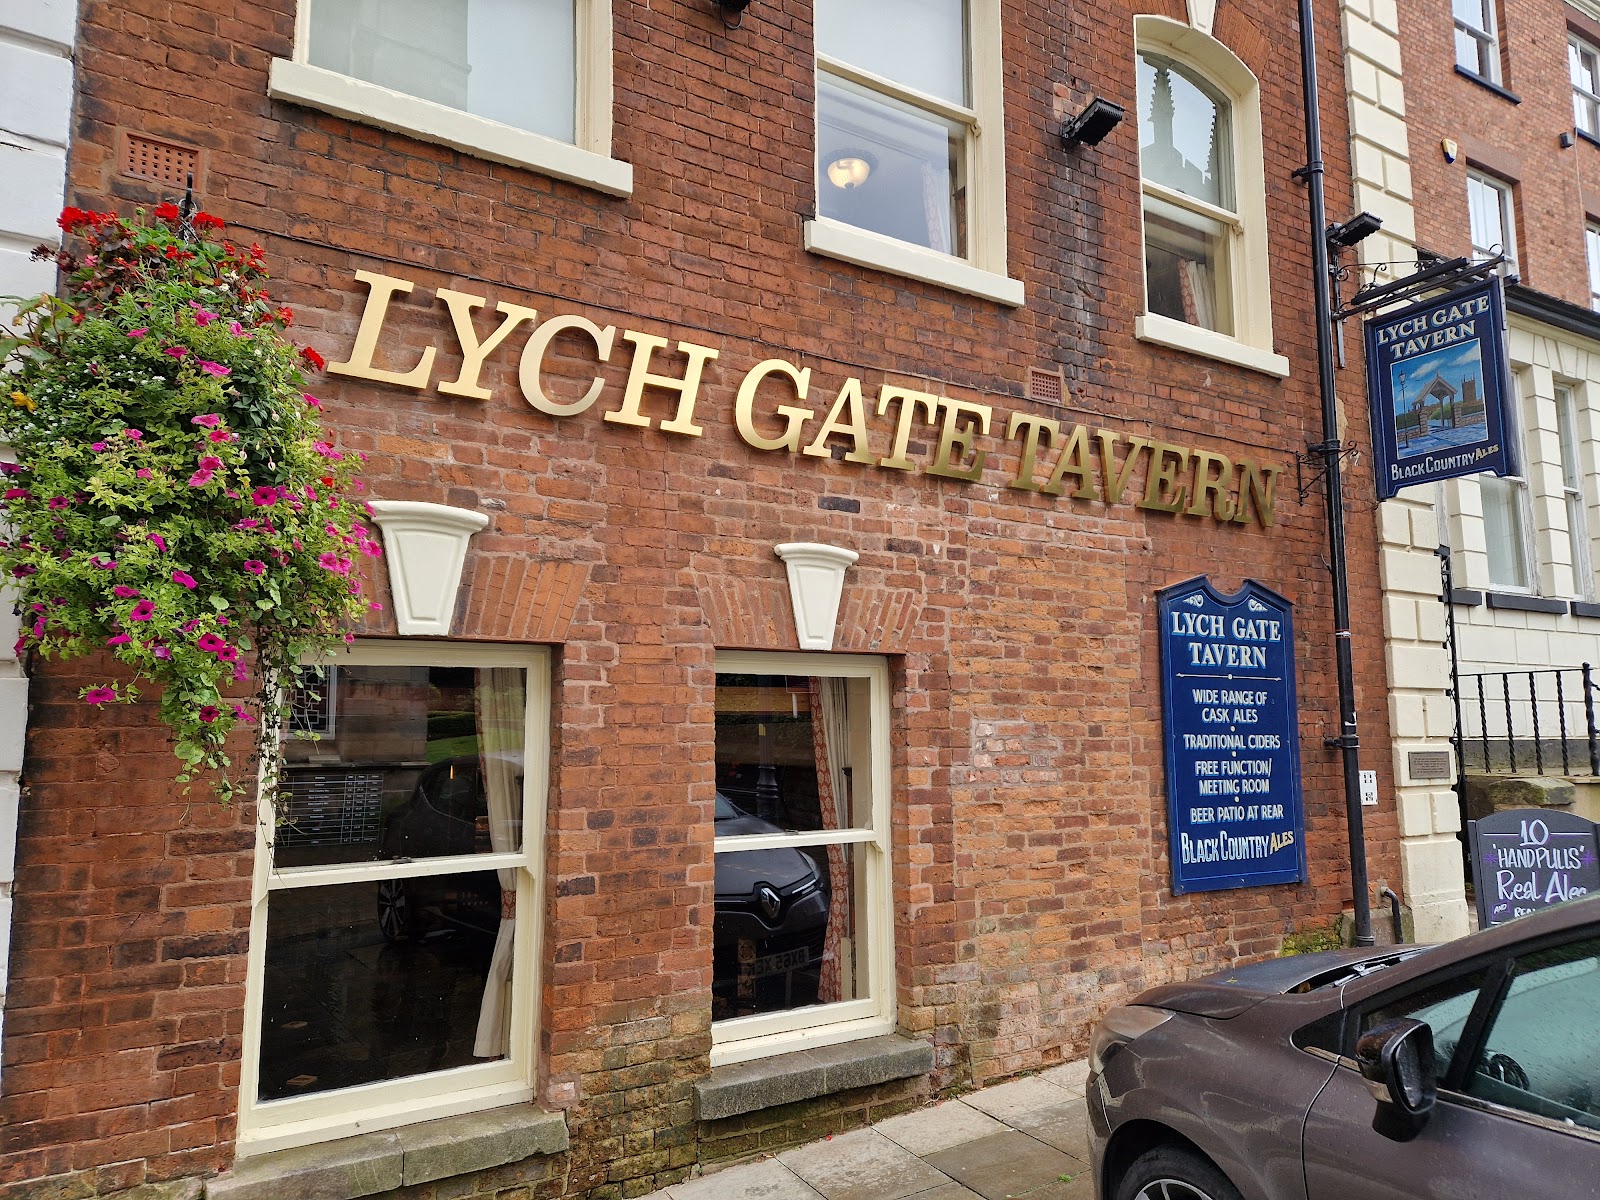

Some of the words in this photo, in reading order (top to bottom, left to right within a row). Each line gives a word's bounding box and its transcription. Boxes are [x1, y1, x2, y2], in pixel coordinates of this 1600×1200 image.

[1377, 315, 1427, 344] LYCH
[1432, 295, 1489, 327] GATE
[1390, 320, 1475, 359] TAVERN
[327, 269, 719, 437] LYCH
[734, 359, 992, 483] GATE
[1007, 411, 1284, 528] TAVERN
[1391, 462, 1426, 481] BLACK
[1426, 453, 1475, 473] COUNTRY
[1475, 444, 1499, 460] ALES
[1171, 611, 1225, 638] LYCH
[1232, 617, 1281, 642] GATE
[1189, 642, 1267, 669] TAVERN
[1192, 689, 1219, 704] WIDE
[1221, 690, 1254, 705] RANGE
[1256, 692, 1267, 706] OF
[1202, 708, 1230, 722] CASK
[1234, 709, 1258, 724] ALES
[1183, 734, 1246, 750] TRADITIONAL
[1248, 735, 1280, 749] CIDERS
[1195, 761, 1219, 776] FREE
[1221, 758, 1272, 777] FUNCTION/
[1199, 779, 1240, 796] MEETING
[1242, 779, 1269, 793] ROOM
[1190, 807, 1215, 824] BEER
[1217, 806, 1245, 822] PATIO
[1247, 806, 1259, 821] AT
[1261, 804, 1283, 820] REAR
[1520, 819, 1549, 846] 10
[1181, 832, 1219, 864] BLACK
[1220, 830, 1269, 860] COUNTRY
[1270, 831, 1294, 855] ALES
[1496, 870, 1541, 901] Real
[1494, 903, 1507, 914] AND
[1514, 908, 1535, 918] REA
